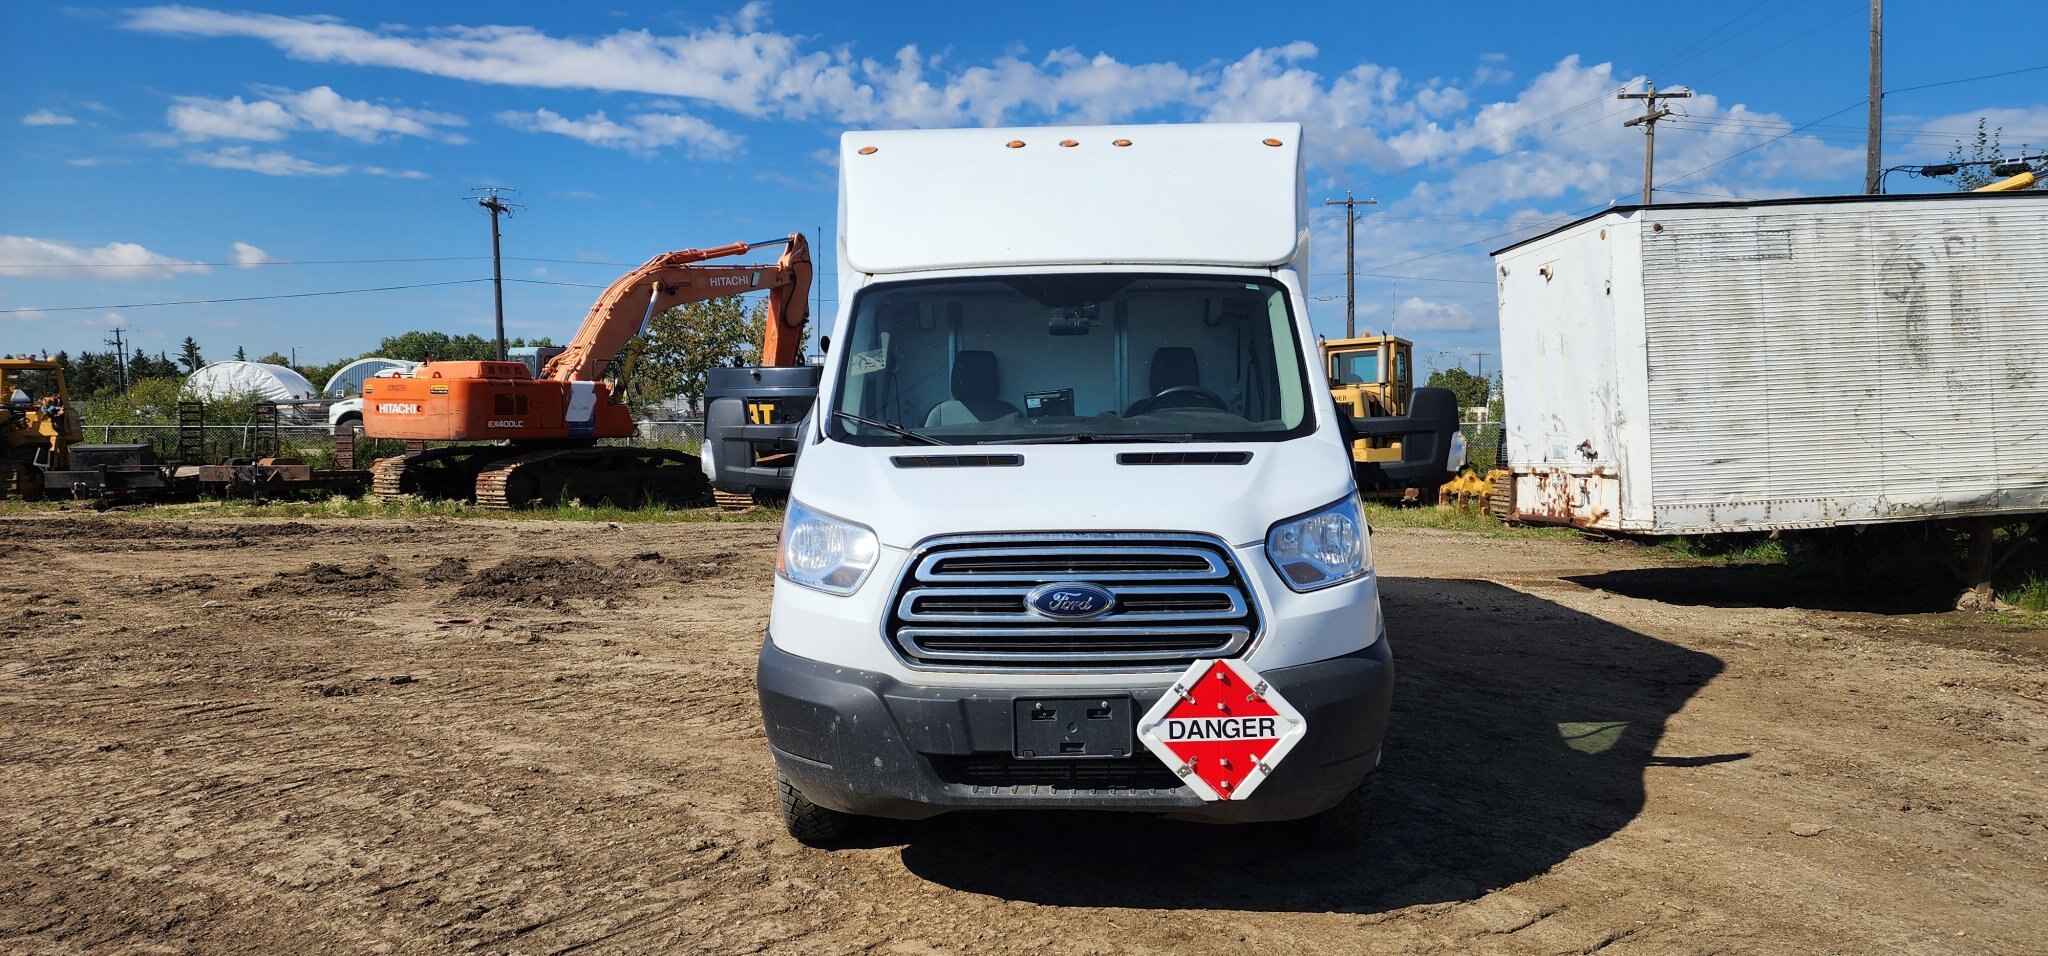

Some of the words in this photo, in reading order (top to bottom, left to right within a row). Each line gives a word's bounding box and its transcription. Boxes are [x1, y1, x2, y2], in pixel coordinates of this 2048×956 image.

[709, 275, 749, 287] HITACHI
[1334, 394, 1347, 402] NER
[379, 403, 417, 414] HITACHI
[748, 403, 775, 425] AT
[487, 420, 524, 428] EX400LC
[1048, 591, 1093, 611] Ford
[1168, 717, 1276, 740] DANGER
